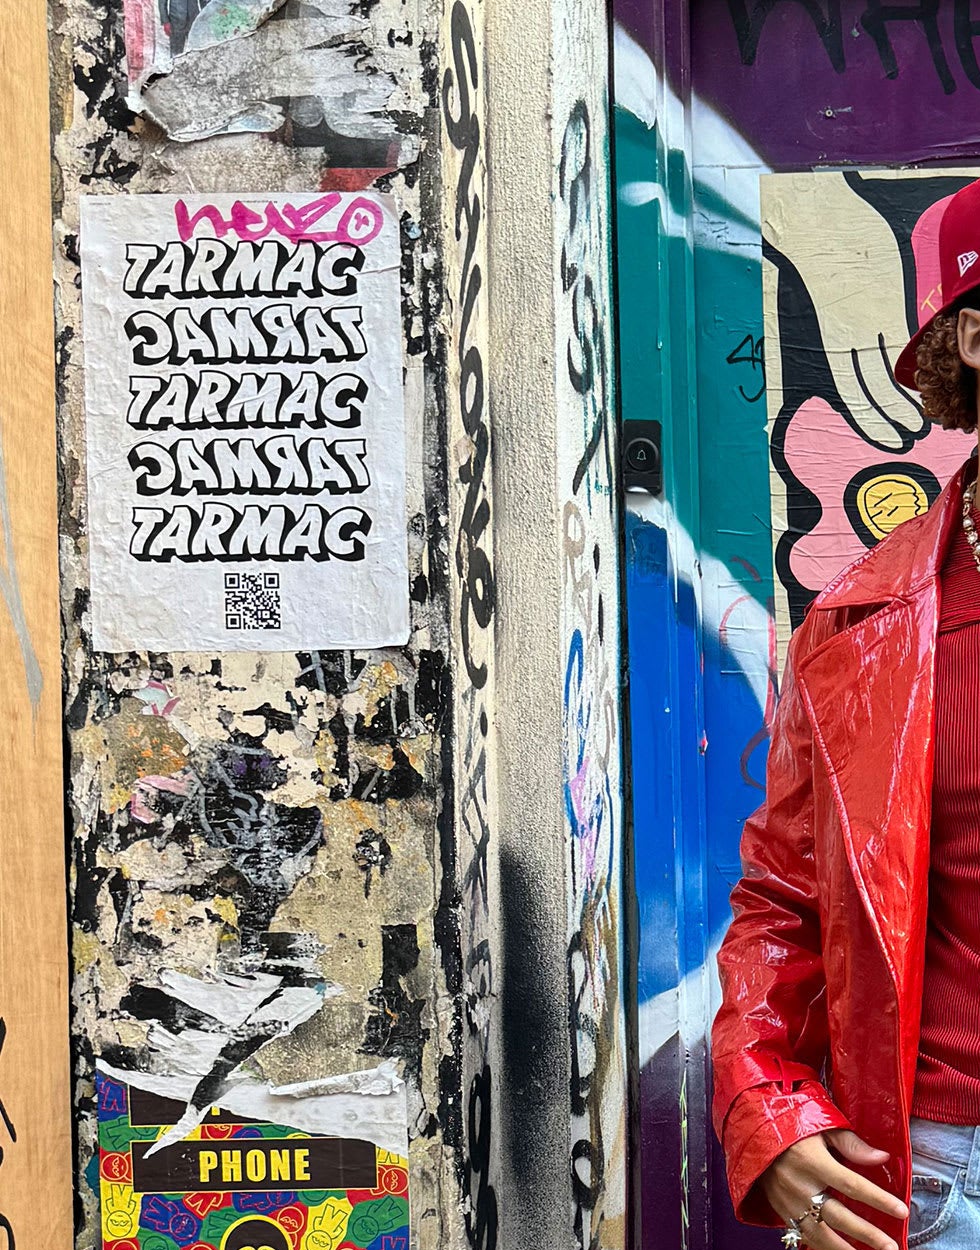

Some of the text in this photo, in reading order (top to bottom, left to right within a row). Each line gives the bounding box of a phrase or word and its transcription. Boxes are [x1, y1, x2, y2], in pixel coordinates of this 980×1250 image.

[123, 238, 366, 299] TARMAC
[126, 370, 369, 431] TARMAC
[129, 501, 373, 563] TARMAC
[199, 1148, 311, 1184] PHONE
